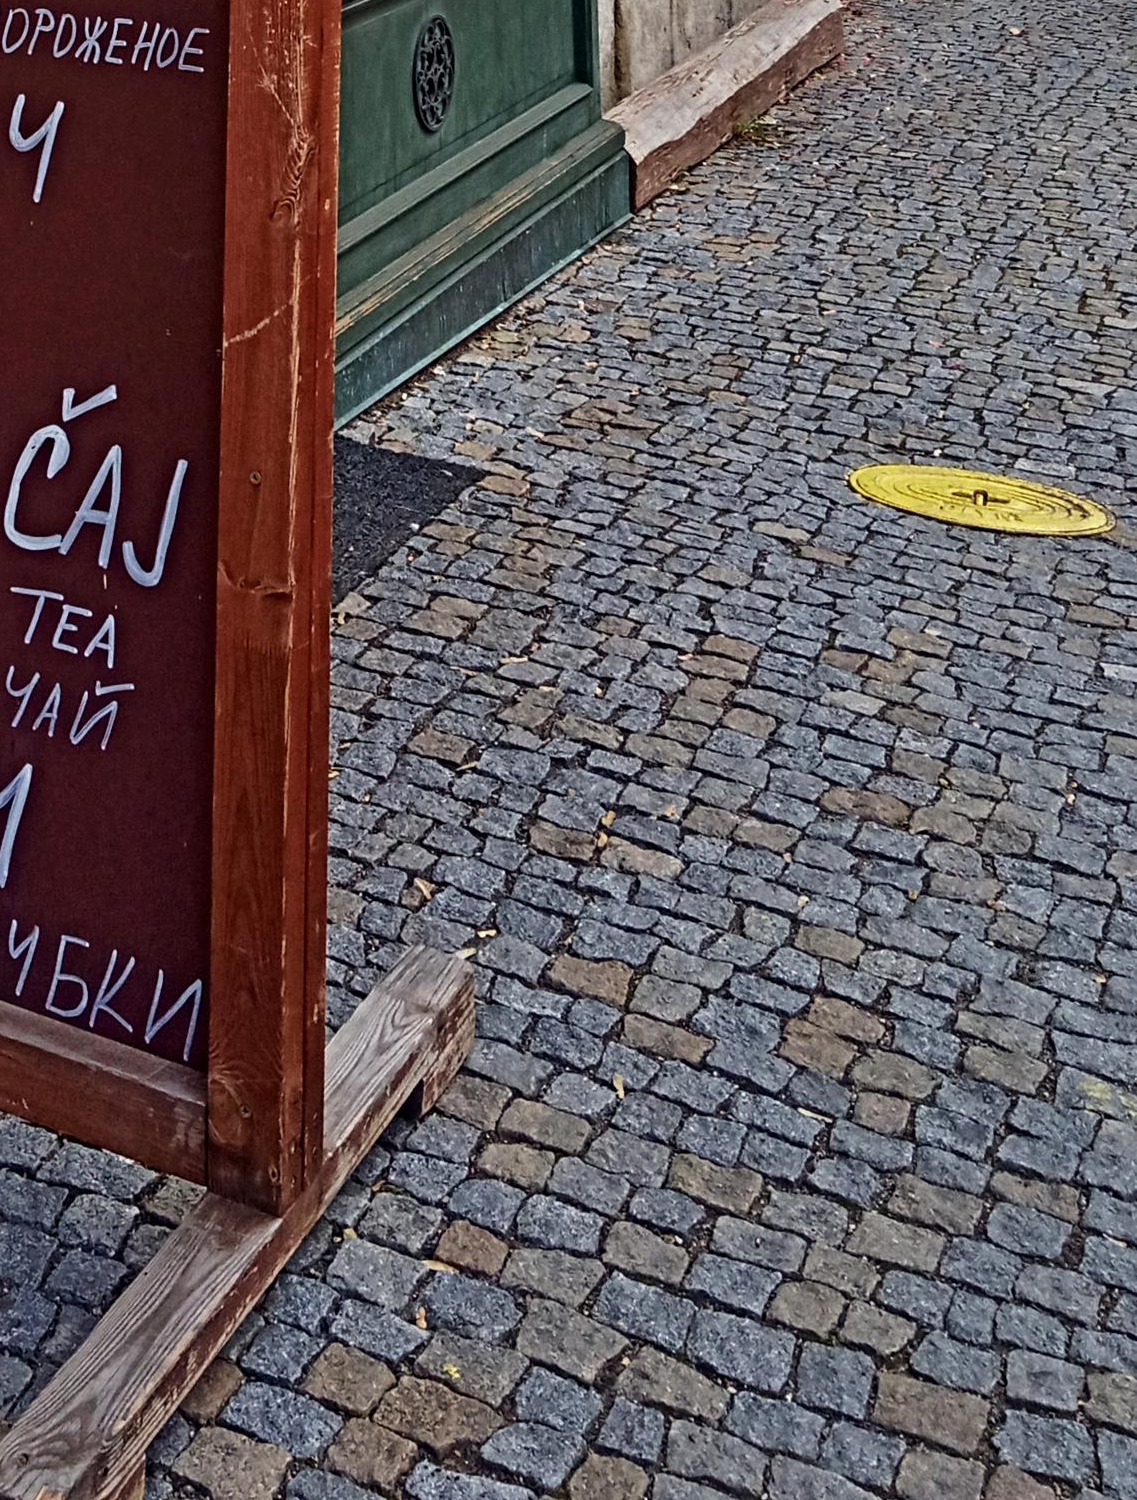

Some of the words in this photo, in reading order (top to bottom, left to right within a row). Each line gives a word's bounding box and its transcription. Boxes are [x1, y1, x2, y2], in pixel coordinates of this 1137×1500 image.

[4, 385, 188, 587] ČAJ
[10, 587, 114, 668] TEA
[6, 665, 134, 750] ЧАЙ
